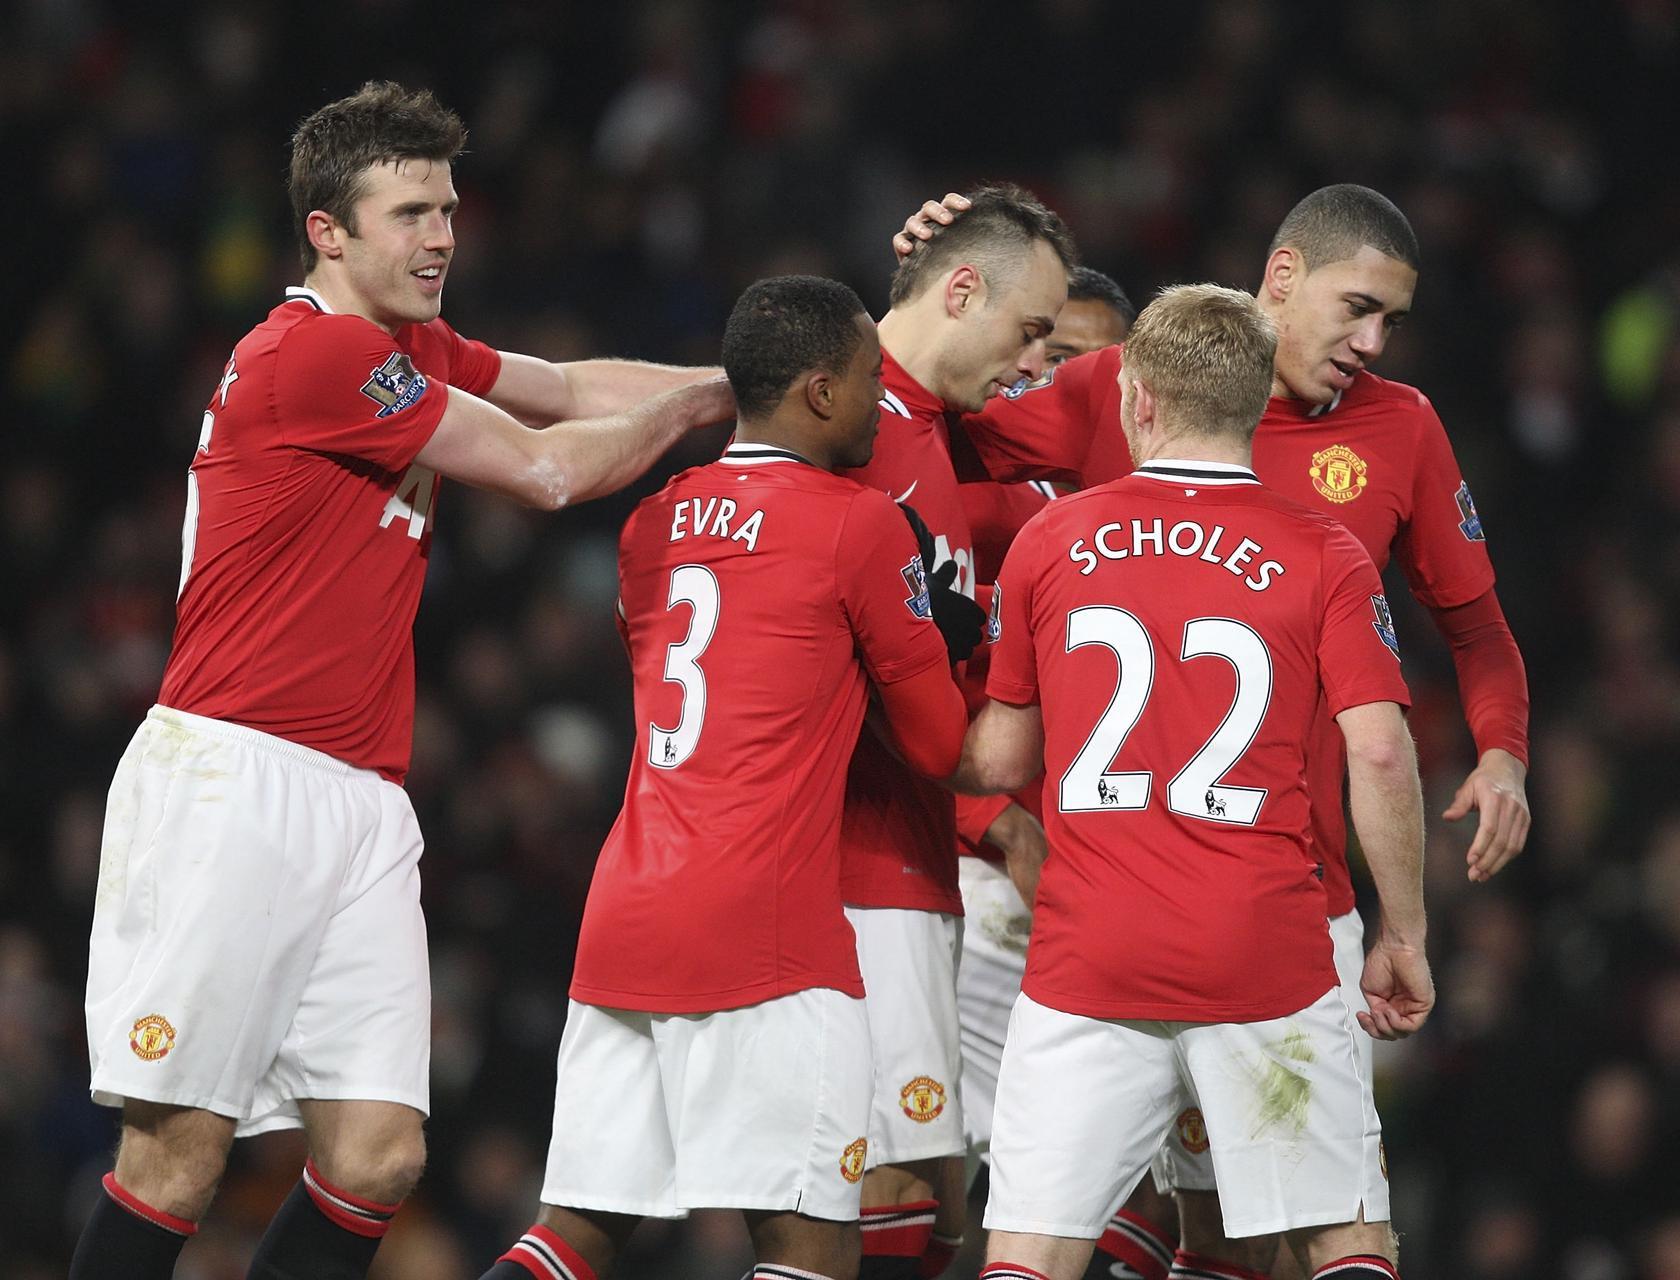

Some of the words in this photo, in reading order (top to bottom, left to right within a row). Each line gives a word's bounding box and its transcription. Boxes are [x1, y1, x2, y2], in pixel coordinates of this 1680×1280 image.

[669, 497, 765, 552] EVRA
[1069, 518, 1285, 592] SCHOLES
[648, 564, 721, 769] 3
[1059, 604, 1273, 826] 22
